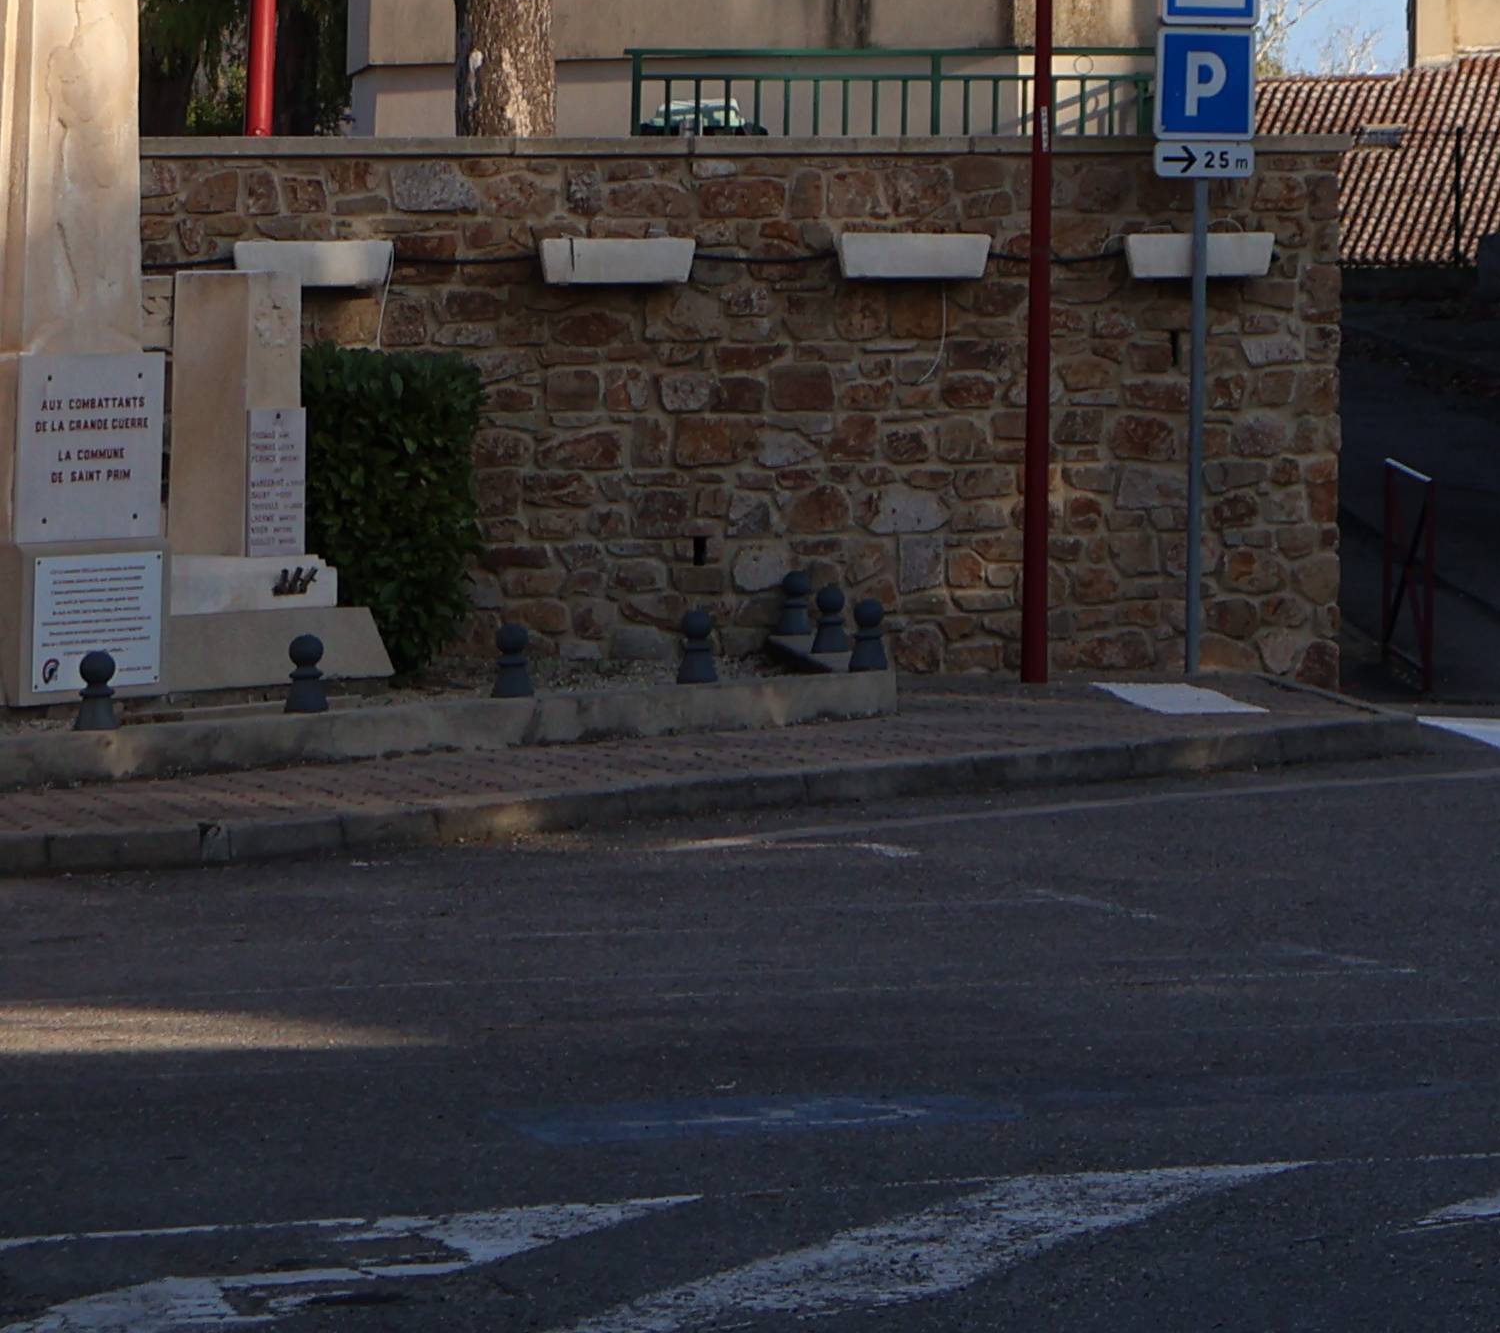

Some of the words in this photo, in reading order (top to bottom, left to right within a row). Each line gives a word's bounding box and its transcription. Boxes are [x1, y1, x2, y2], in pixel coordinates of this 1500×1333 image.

[1184, 50, 1227, 117] P
[1203, 150, 1230, 170] 25
[1235, 158, 1249, 171] m
[41, 398, 62, 412] AUX
[69, 396, 145, 410] COMBATTANTS
[35, 420, 48, 433] DE
[51, 420, 65, 432] LA
[69, 418, 108, 432] GRANDE
[111, 417, 149, 430] GUERRE
[58, 450, 72, 462] LA
[77, 447, 125, 461] COMMUNE
[51, 471, 63, 483] DE
[70, 470, 101, 483] SAINT
[106, 469, 131, 482] PRIM
